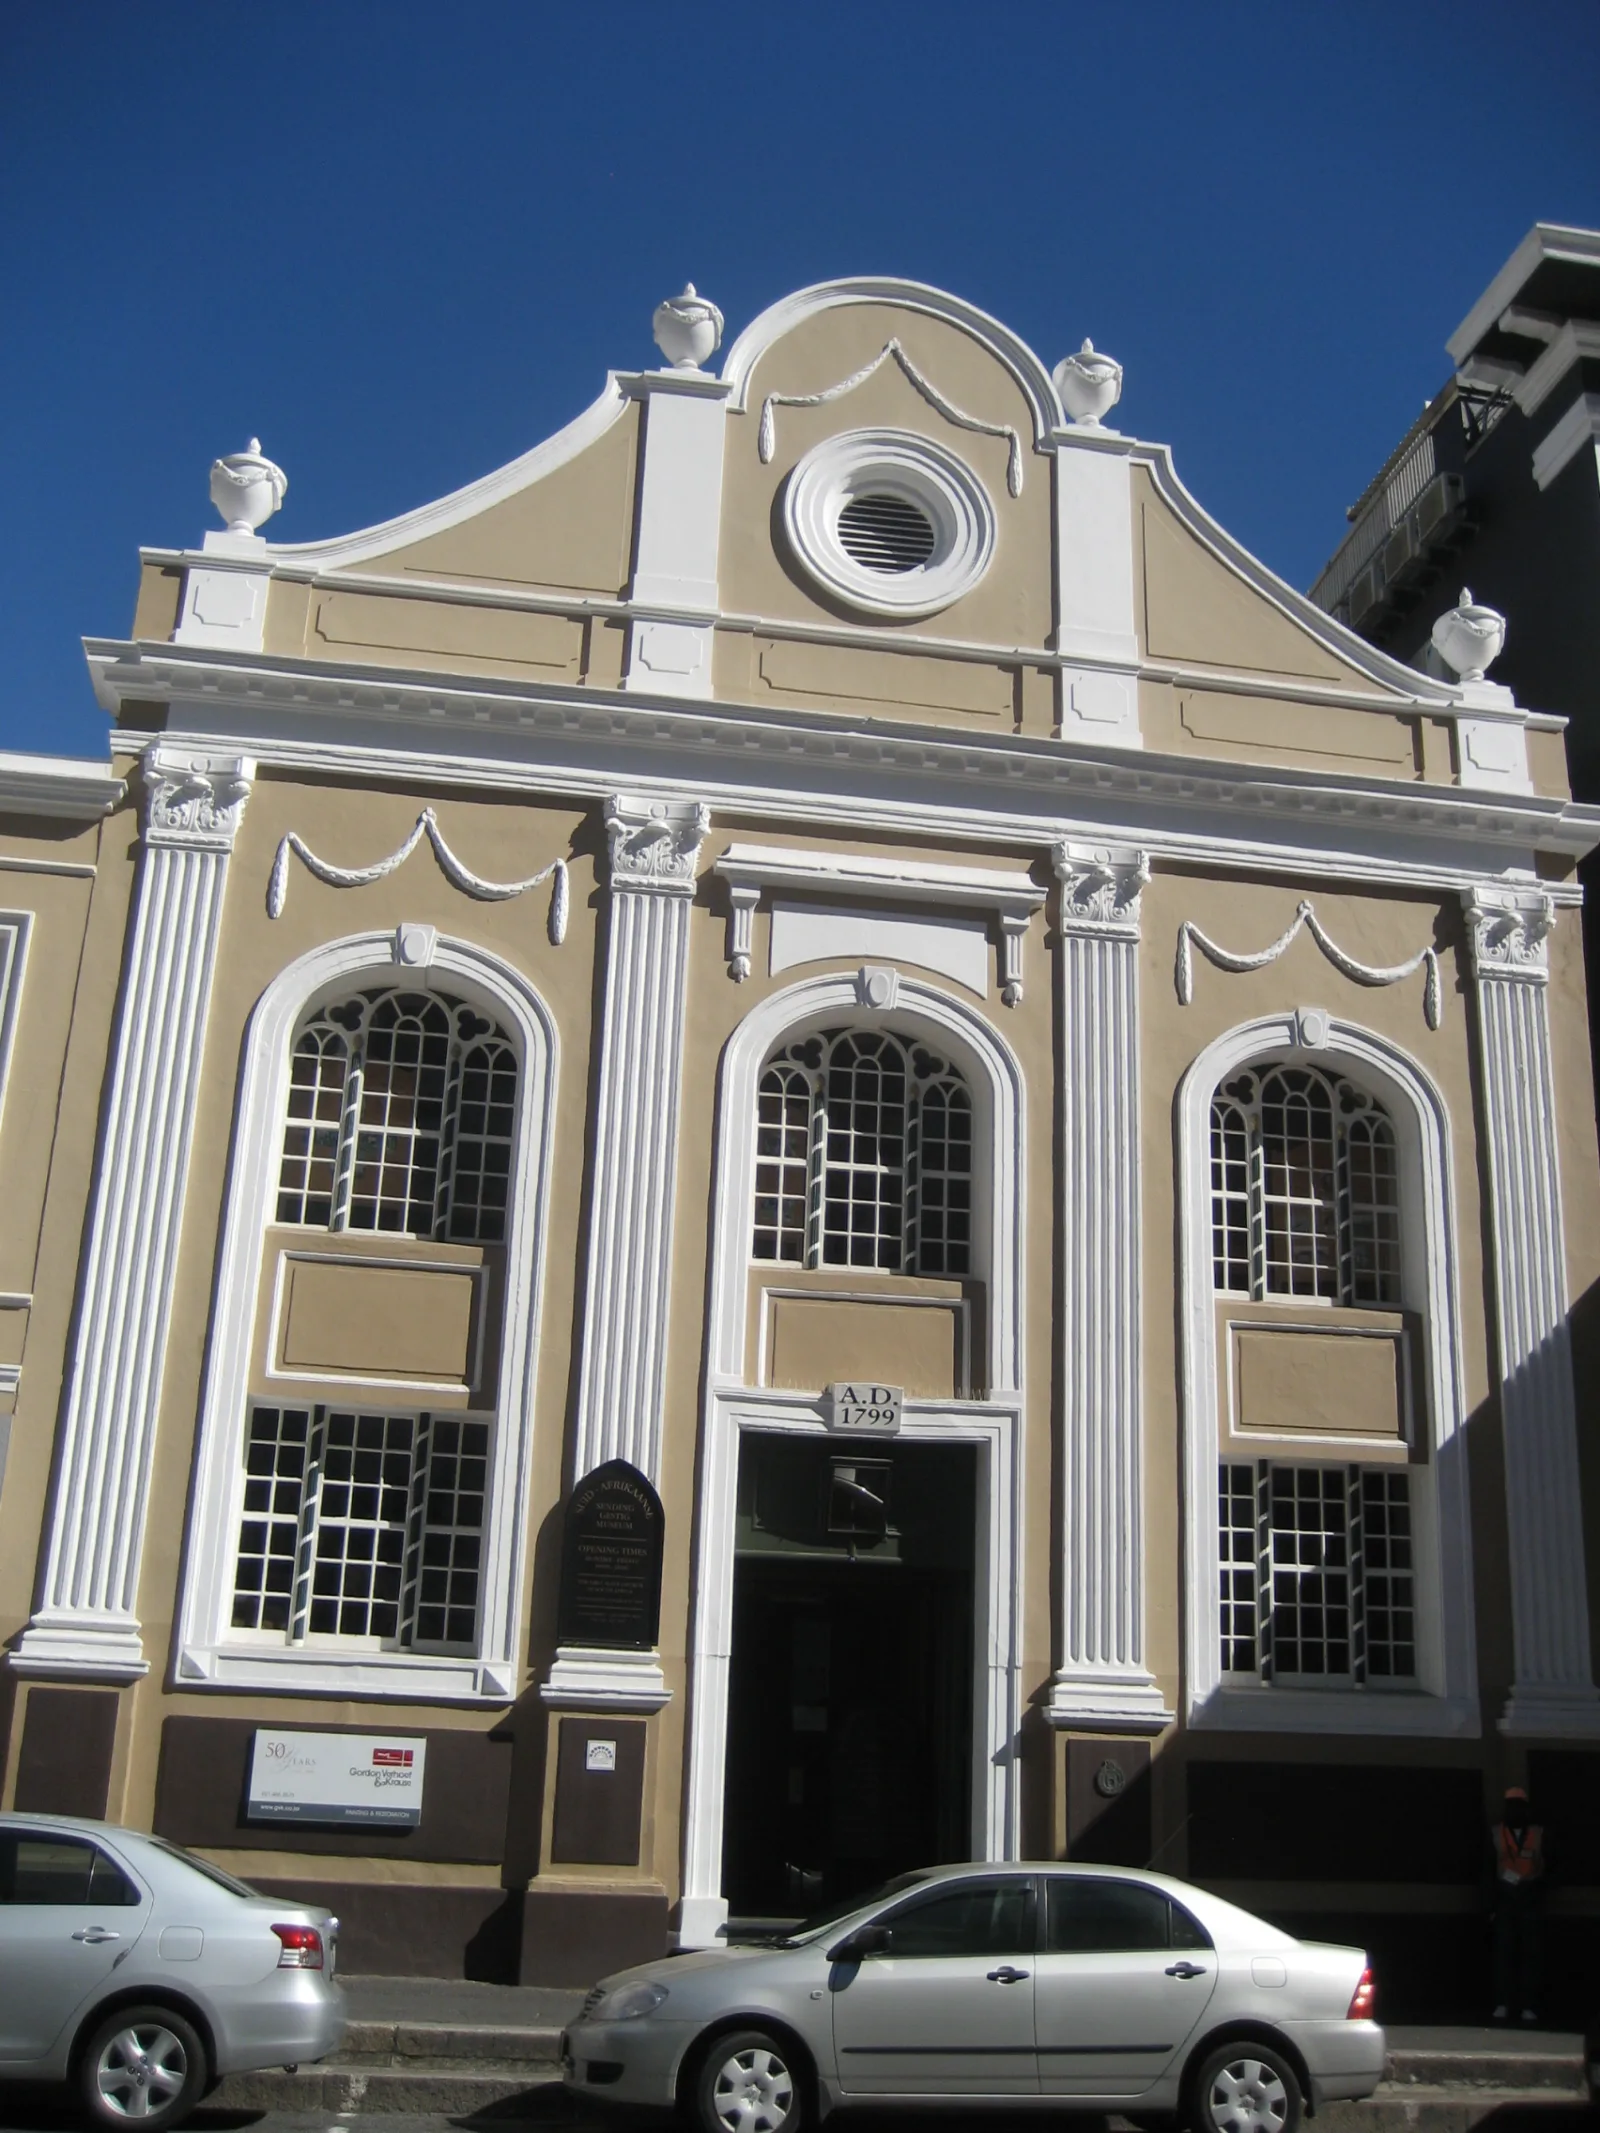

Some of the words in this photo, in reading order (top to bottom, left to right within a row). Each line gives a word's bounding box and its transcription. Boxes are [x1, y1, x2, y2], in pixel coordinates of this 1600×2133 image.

[839, 1386, 898, 1405] A.D.
[841, 1407, 895, 1426] 1799
[595, 1502, 635, 1512] SENDING
[596, 1520, 633, 1530] MUSEUM
[578, 1545, 620, 1555] OPENING
[622, 1547, 648, 1557] TIMES
[265, 1742, 286, 1760] 50
[349, 1767, 381, 1778] Gordon
